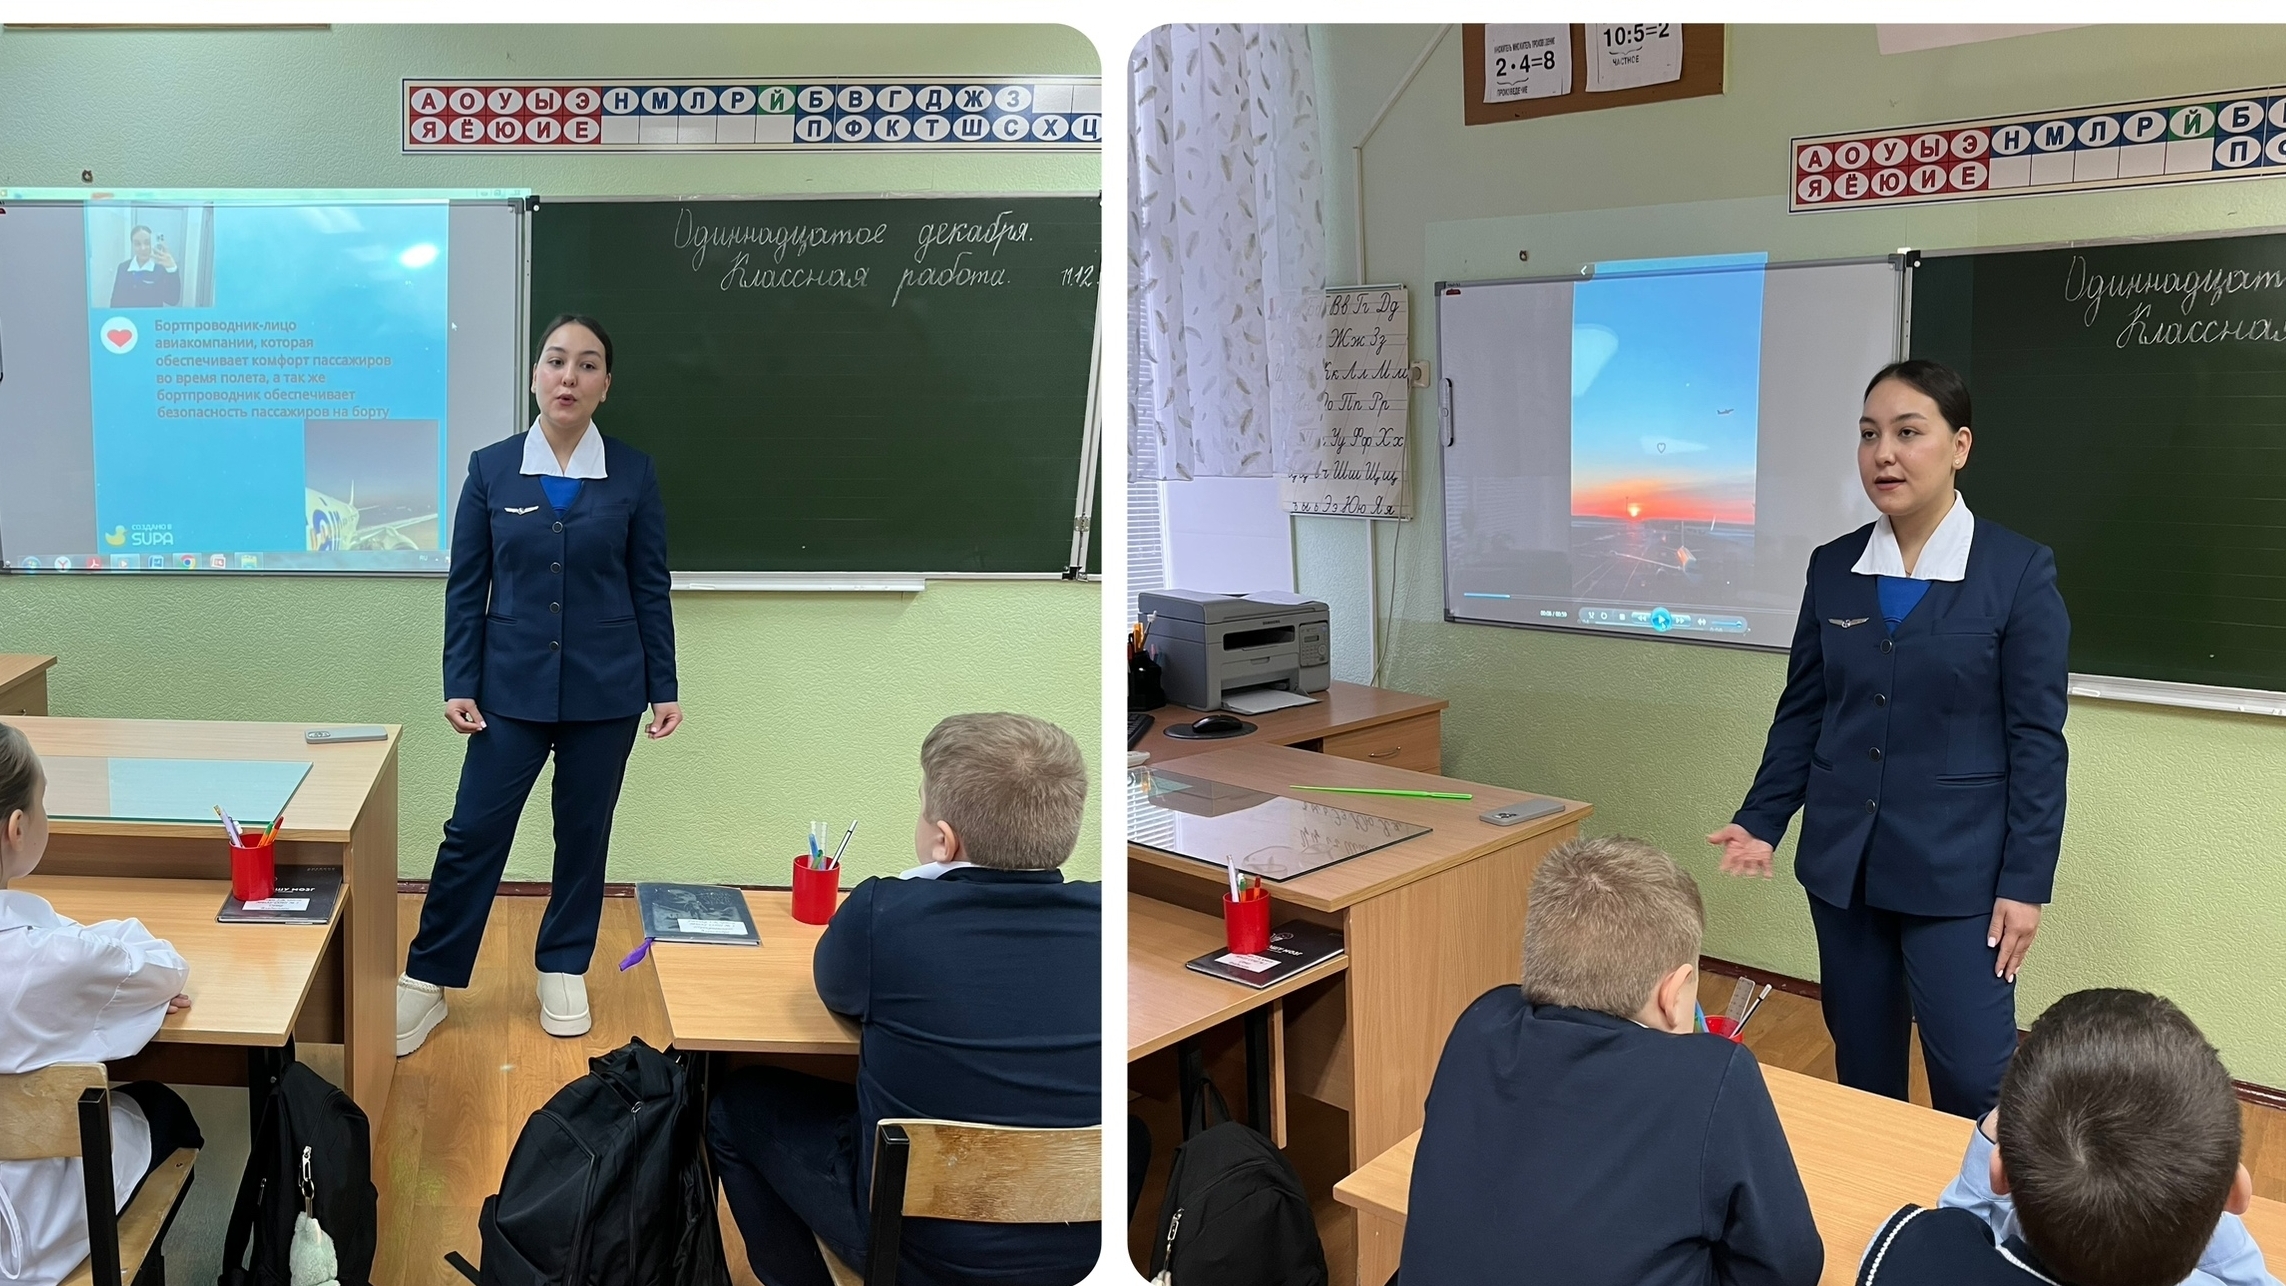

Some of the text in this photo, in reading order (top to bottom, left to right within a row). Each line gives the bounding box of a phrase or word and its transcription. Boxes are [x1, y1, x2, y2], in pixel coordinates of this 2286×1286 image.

[1613, 55, 1639, 66] ЧАСТНОЕ
[674, 208, 1033, 271] Одиннадцатое декабря.
[720, 251, 1011, 308] Классная работа.
[154, 320, 297, 334] Бортпроводник-лицо
[155, 338, 314, 351] авиакомпании, которая
[156, 353, 392, 368] обеспечивает комфорт пассажиров
[157, 373, 326, 386] во время полета, а так же
[157, 389, 356, 403] бортпроводник обеспечивает
[157, 406, 390, 420] безопасность пассажиров на борту
[131, 532, 174, 546] SUPA
